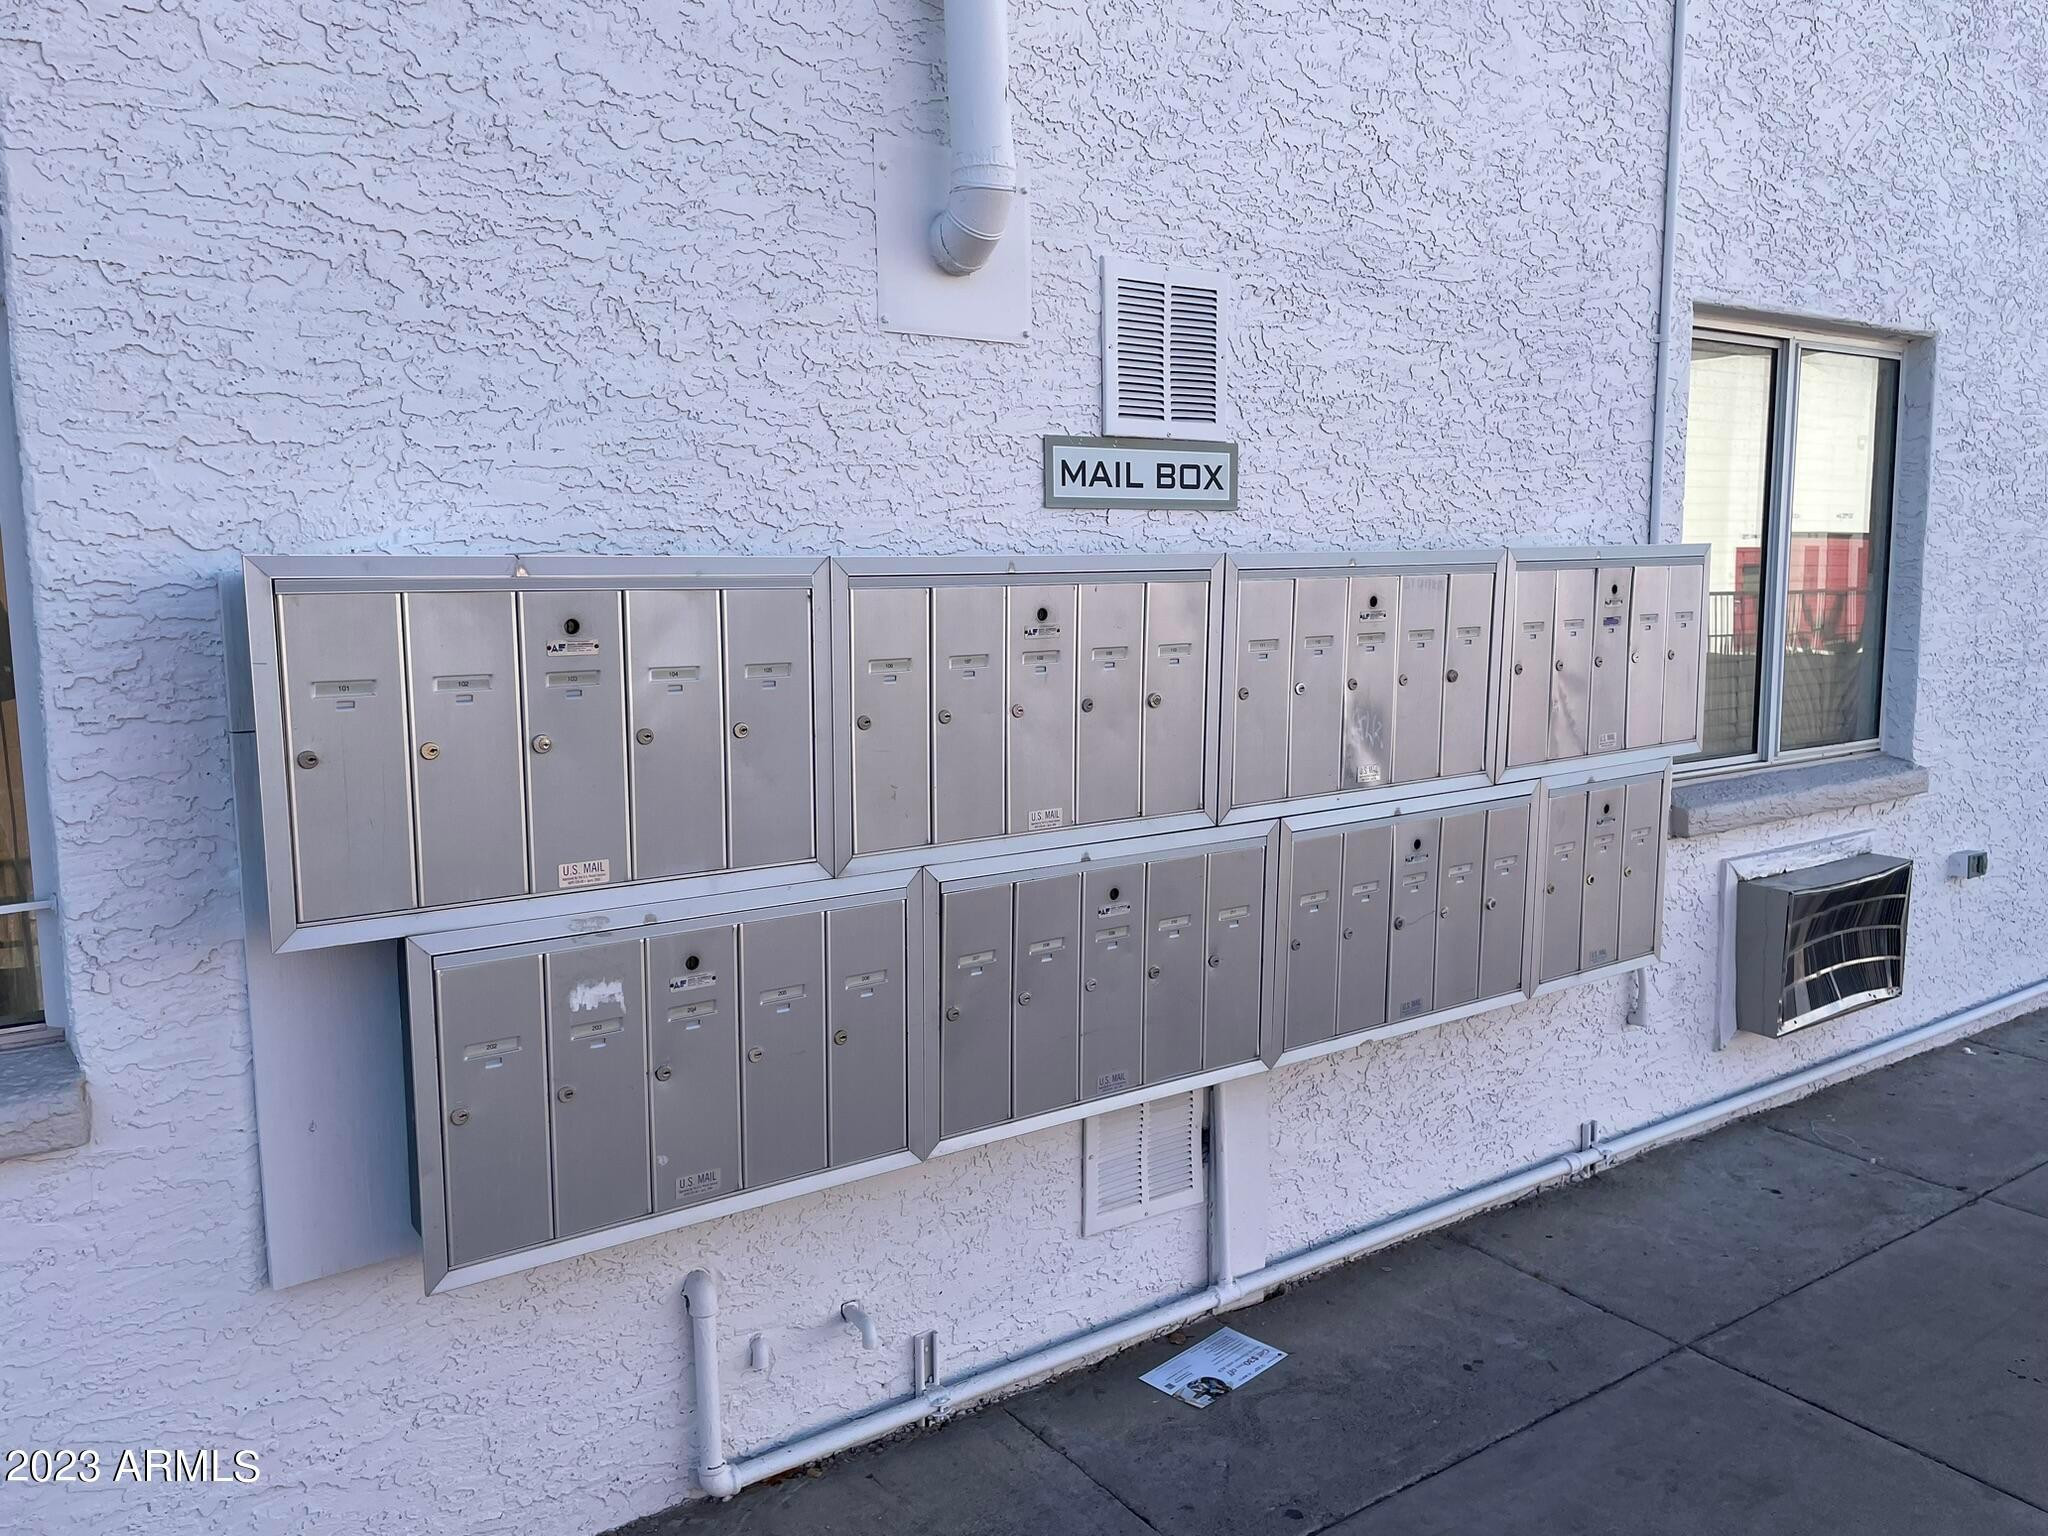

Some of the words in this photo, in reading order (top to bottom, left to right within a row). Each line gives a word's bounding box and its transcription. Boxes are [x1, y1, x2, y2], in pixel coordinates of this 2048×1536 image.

[1061, 459, 1144, 489] MAIL
[1156, 462, 1224, 491] BOX
[583, 861, 605, 874] MAIL
[697, 1171, 718, 1184] MAIL
